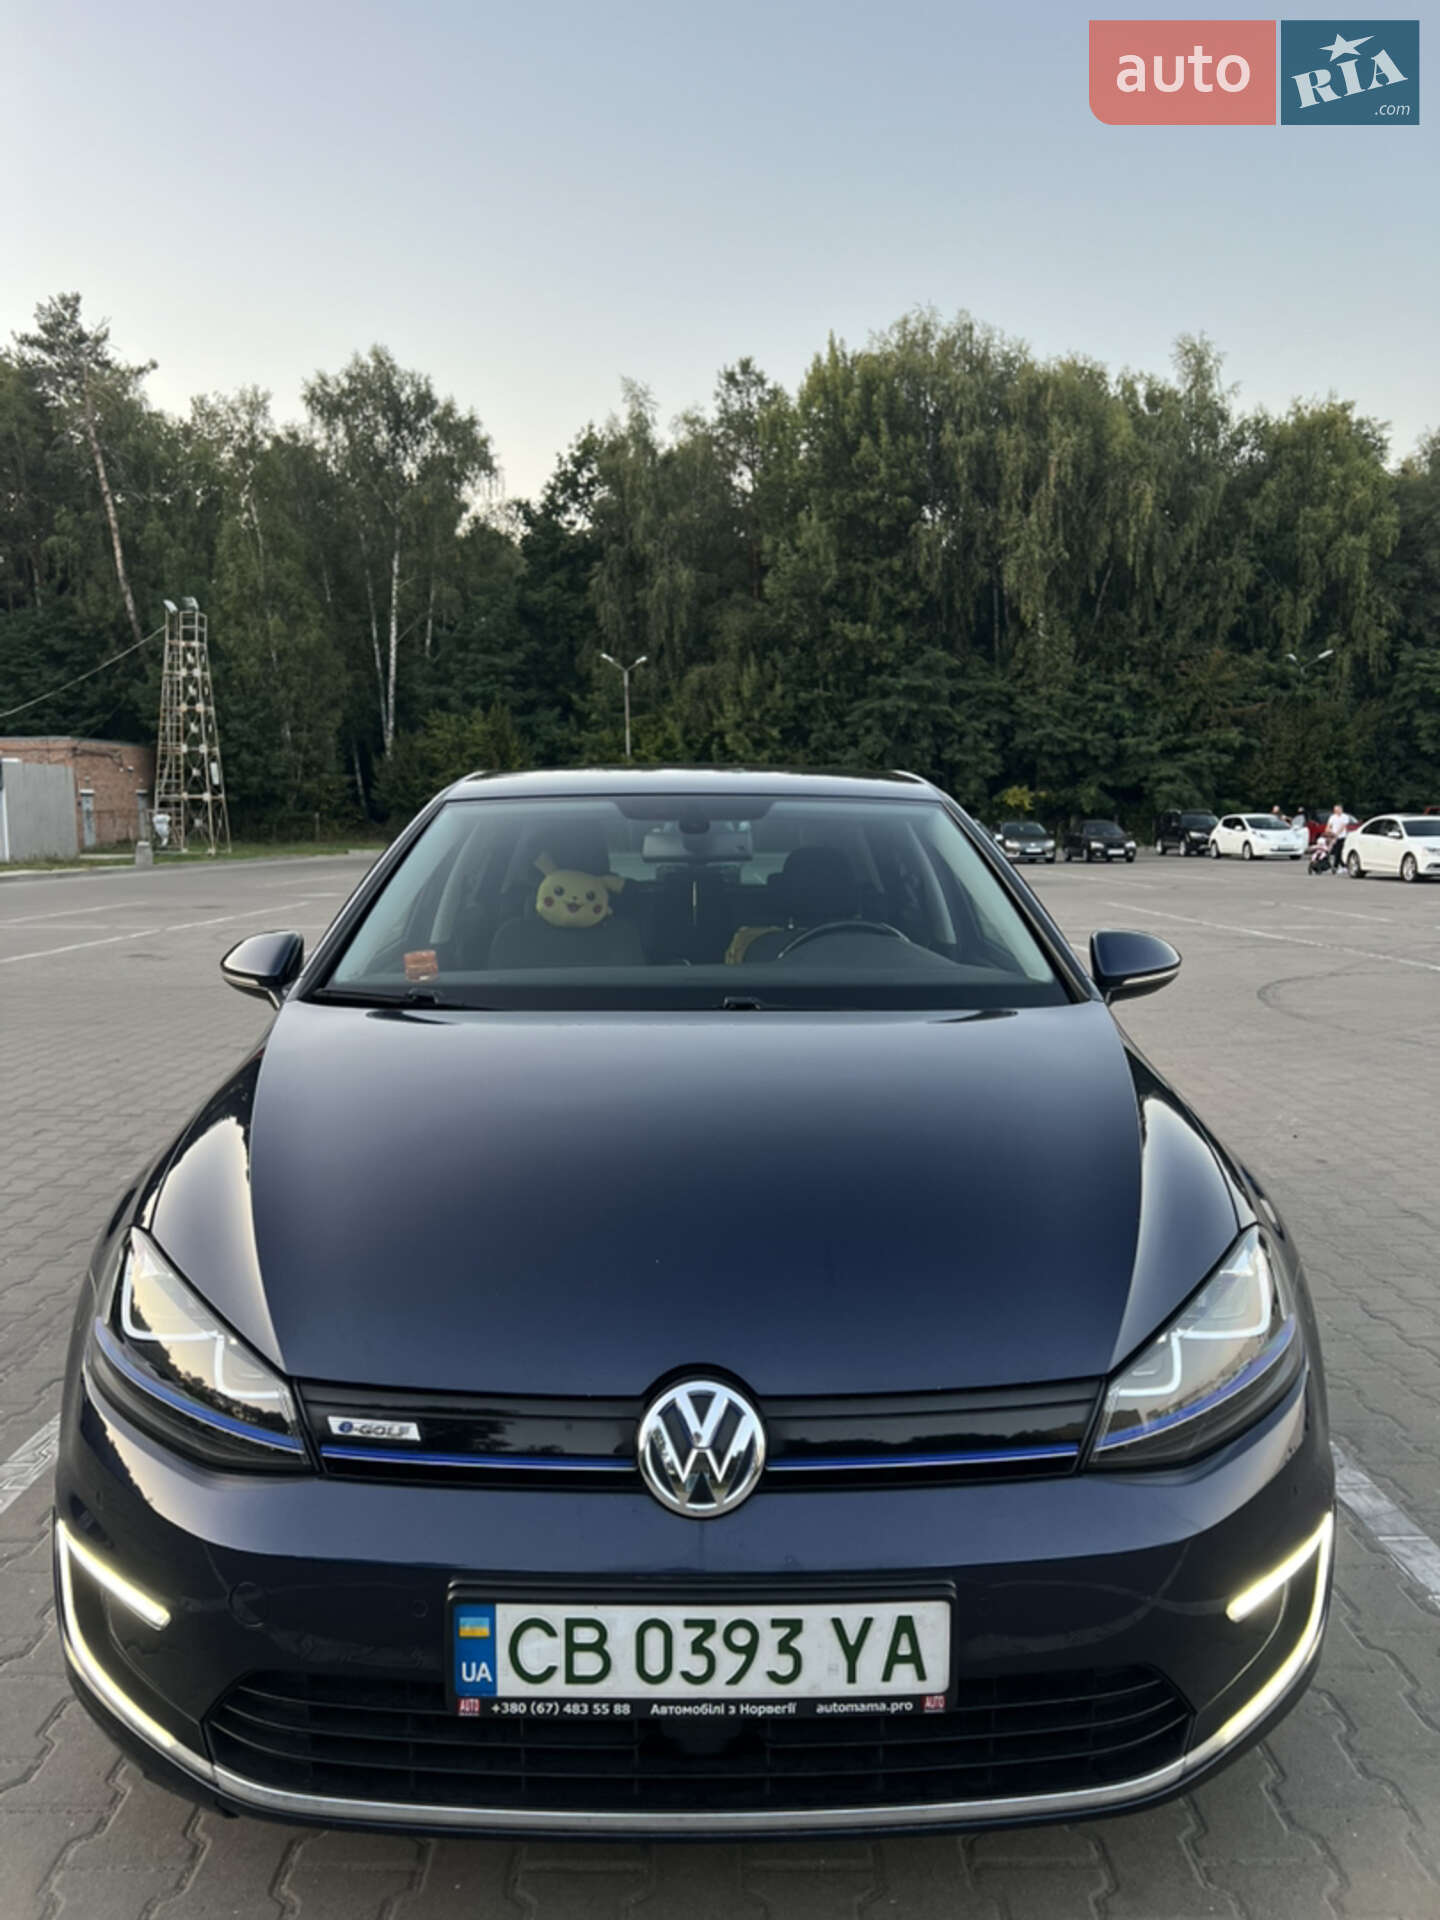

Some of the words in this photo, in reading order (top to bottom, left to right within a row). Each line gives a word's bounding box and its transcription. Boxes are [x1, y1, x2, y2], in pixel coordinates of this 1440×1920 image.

[508, 1617, 612, 1685] CB
[634, 1617, 804, 1685] 0393
[831, 1615, 927, 1685] YA
[461, 1662, 493, 1683] UA
[491, 1702, 527, 1714] +380
[530, 1701, 560, 1715] (67)
[562, 1702, 589, 1714] 483
[592, 1703, 610, 1715] 55
[612, 1703, 631, 1715] 88
[650, 1703, 724, 1715] Автомобілі
[740, 1702, 797, 1717] Норвегії
[816, 1701, 913, 1714] automama.pro
